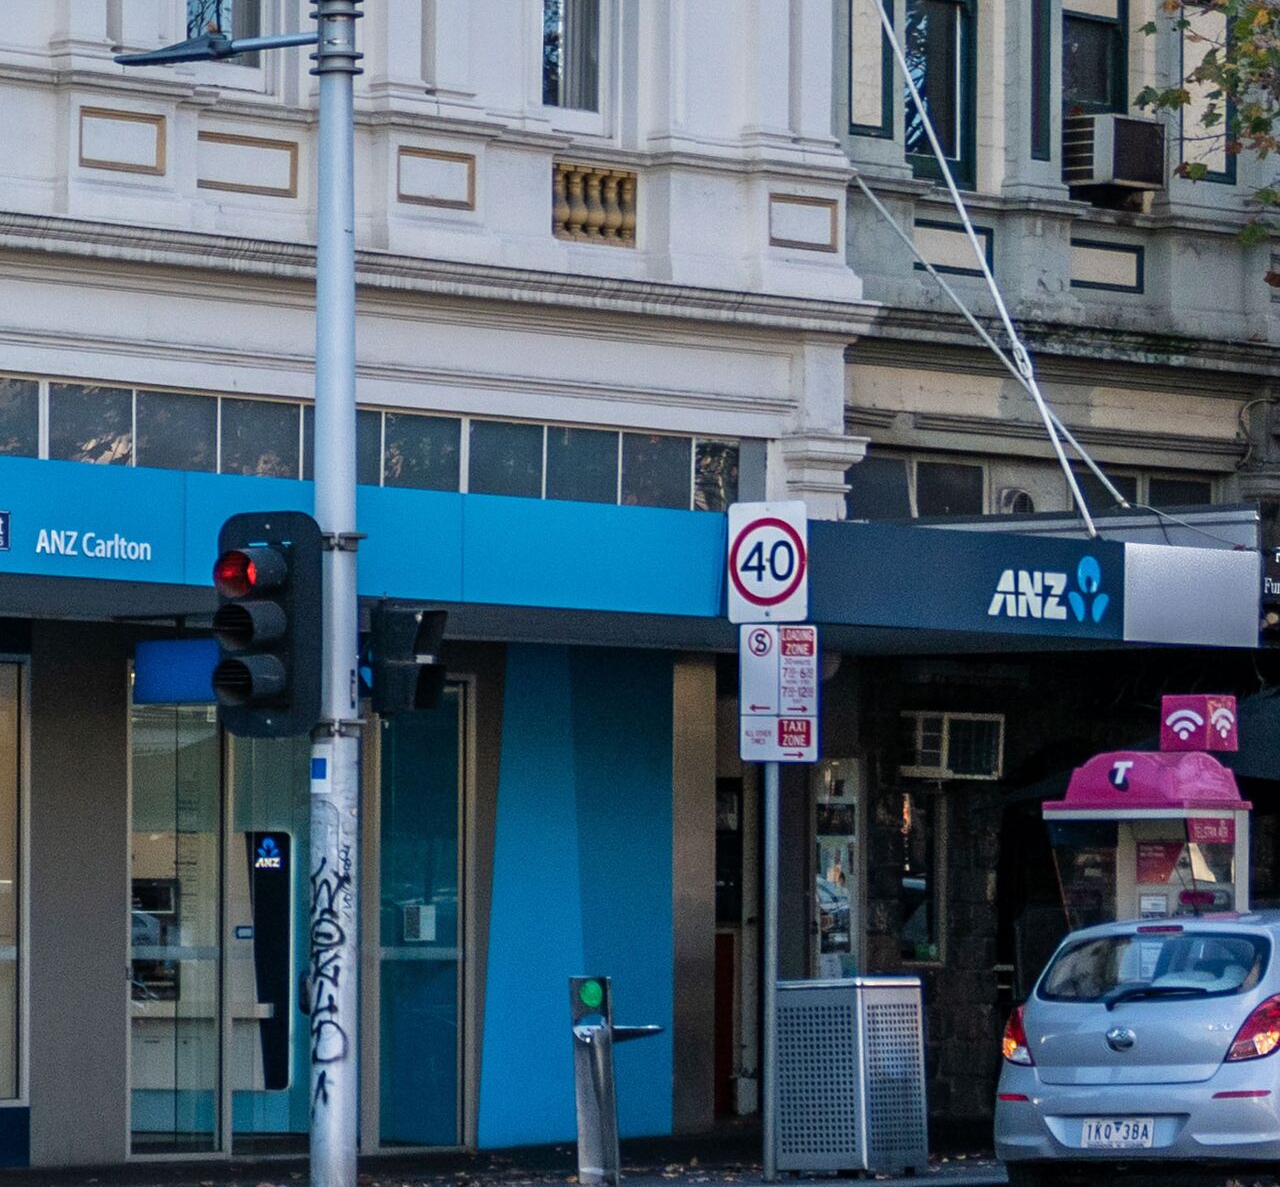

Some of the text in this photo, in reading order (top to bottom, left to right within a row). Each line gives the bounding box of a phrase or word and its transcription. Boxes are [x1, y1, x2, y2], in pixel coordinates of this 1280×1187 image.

[35, 529, 152, 561] ANZ Carlton
[740, 539, 795, 582] 40
[987, 569, 1068, 620] ANZ
[782, 629, 813, 641] LOADING
[785, 644, 810, 655] ZONE
[783, 720, 806, 732] TAXI
[783, 734, 806, 746] ZONE
[255, 857, 281, 868] ANZ
